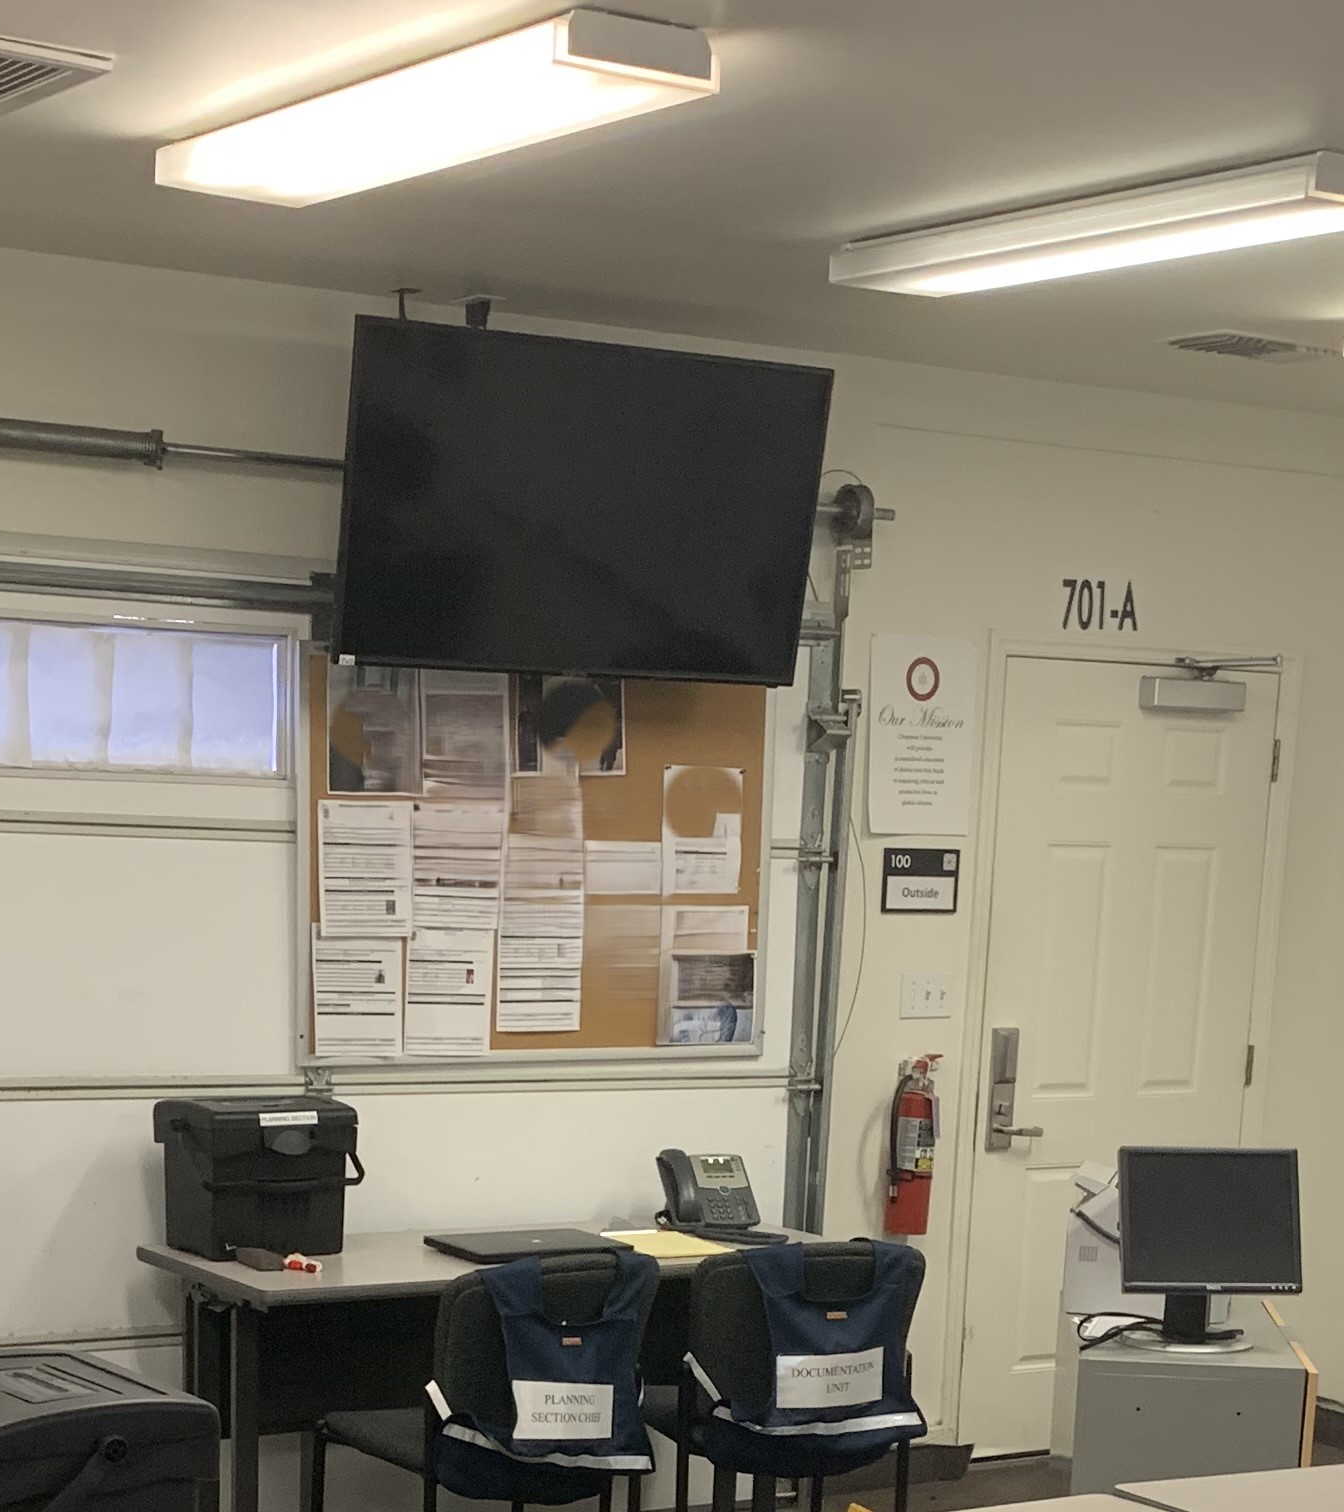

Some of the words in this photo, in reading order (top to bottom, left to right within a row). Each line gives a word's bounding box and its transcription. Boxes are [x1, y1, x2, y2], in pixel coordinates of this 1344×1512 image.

[1062, 578, 1137, 631] 701-A
[878, 704, 906, 727] Our
[909, 705, 963, 728] Mission
[891, 854, 911, 868] 100
[901, 886, 939, 899] Outside
[791, 1361, 874, 1378] DOCUMENTATION
[826, 1382, 849, 1393] UNIT
[544, 1394, 595, 1405] PLANNING
[531, 1412, 577, 1423] SECTION
[578, 1412, 602, 1423] CHIEF
